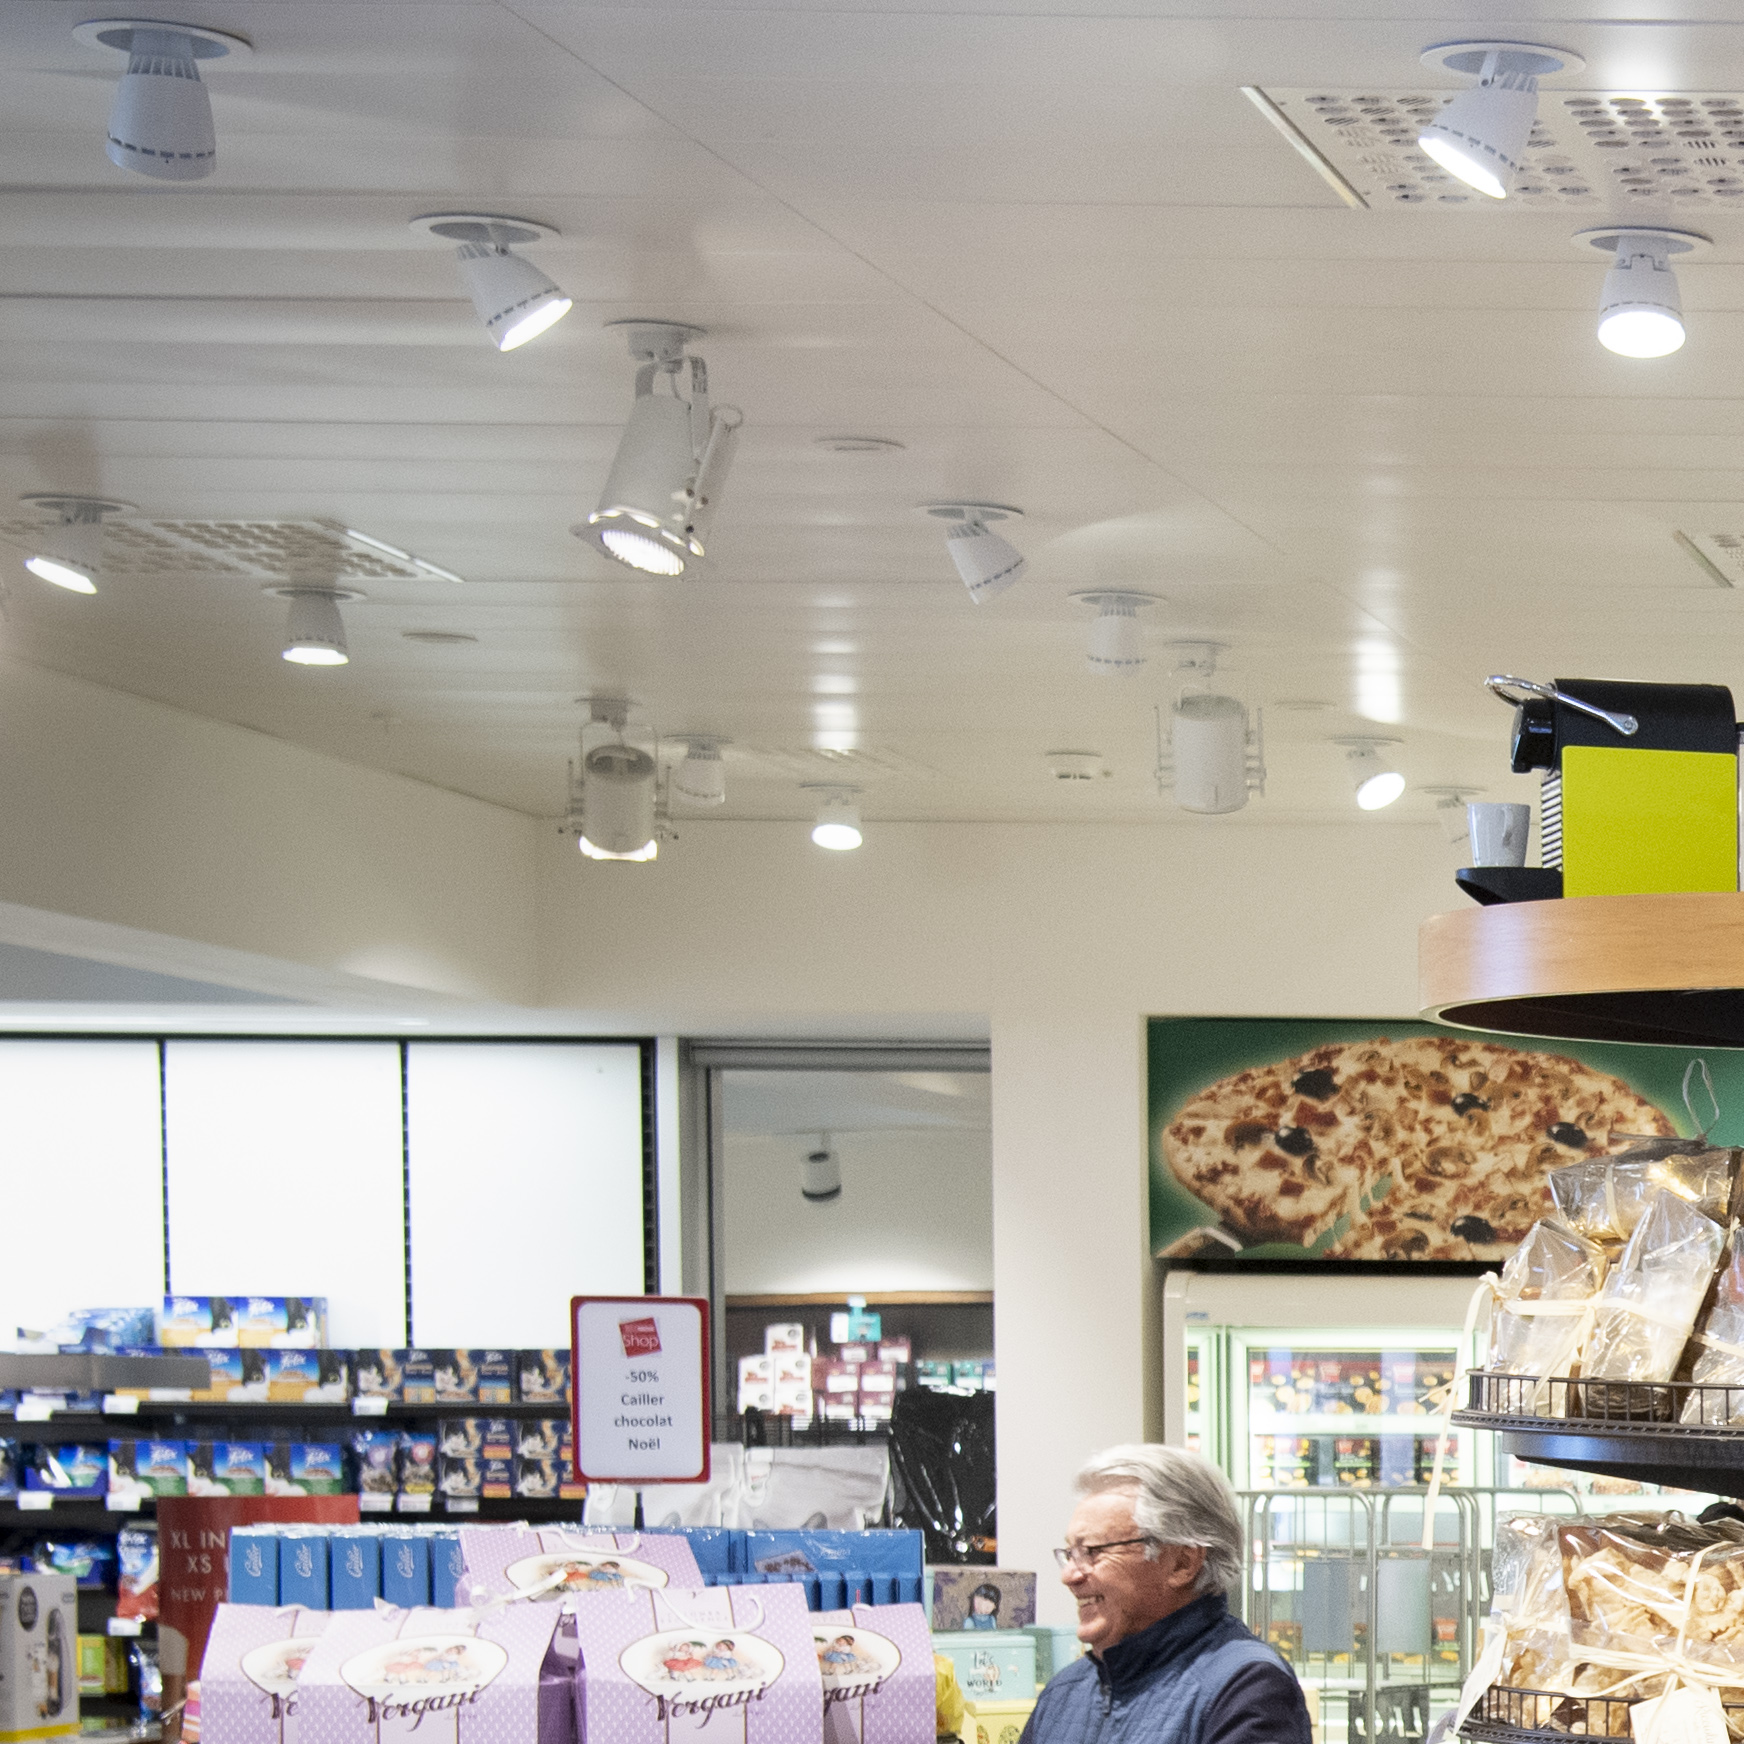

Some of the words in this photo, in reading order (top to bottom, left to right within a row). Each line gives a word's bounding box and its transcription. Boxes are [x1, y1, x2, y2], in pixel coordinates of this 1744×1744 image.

[624, 1334, 659, 1350] Shop
[625, 1371, 659, 1383] -50%
[621, 1394, 665, 1406] Cailler
[614, 1415, 673, 1428] chocolat
[628, 1438, 660, 1451] Noël
[171, 1531, 192, 1548] XL
[187, 1556, 212, 1573] XS
[171, 1589, 205, 1601] NEW
[356, 1684, 481, 1733] Vergani
[646, 1681, 769, 1730] Vergani
